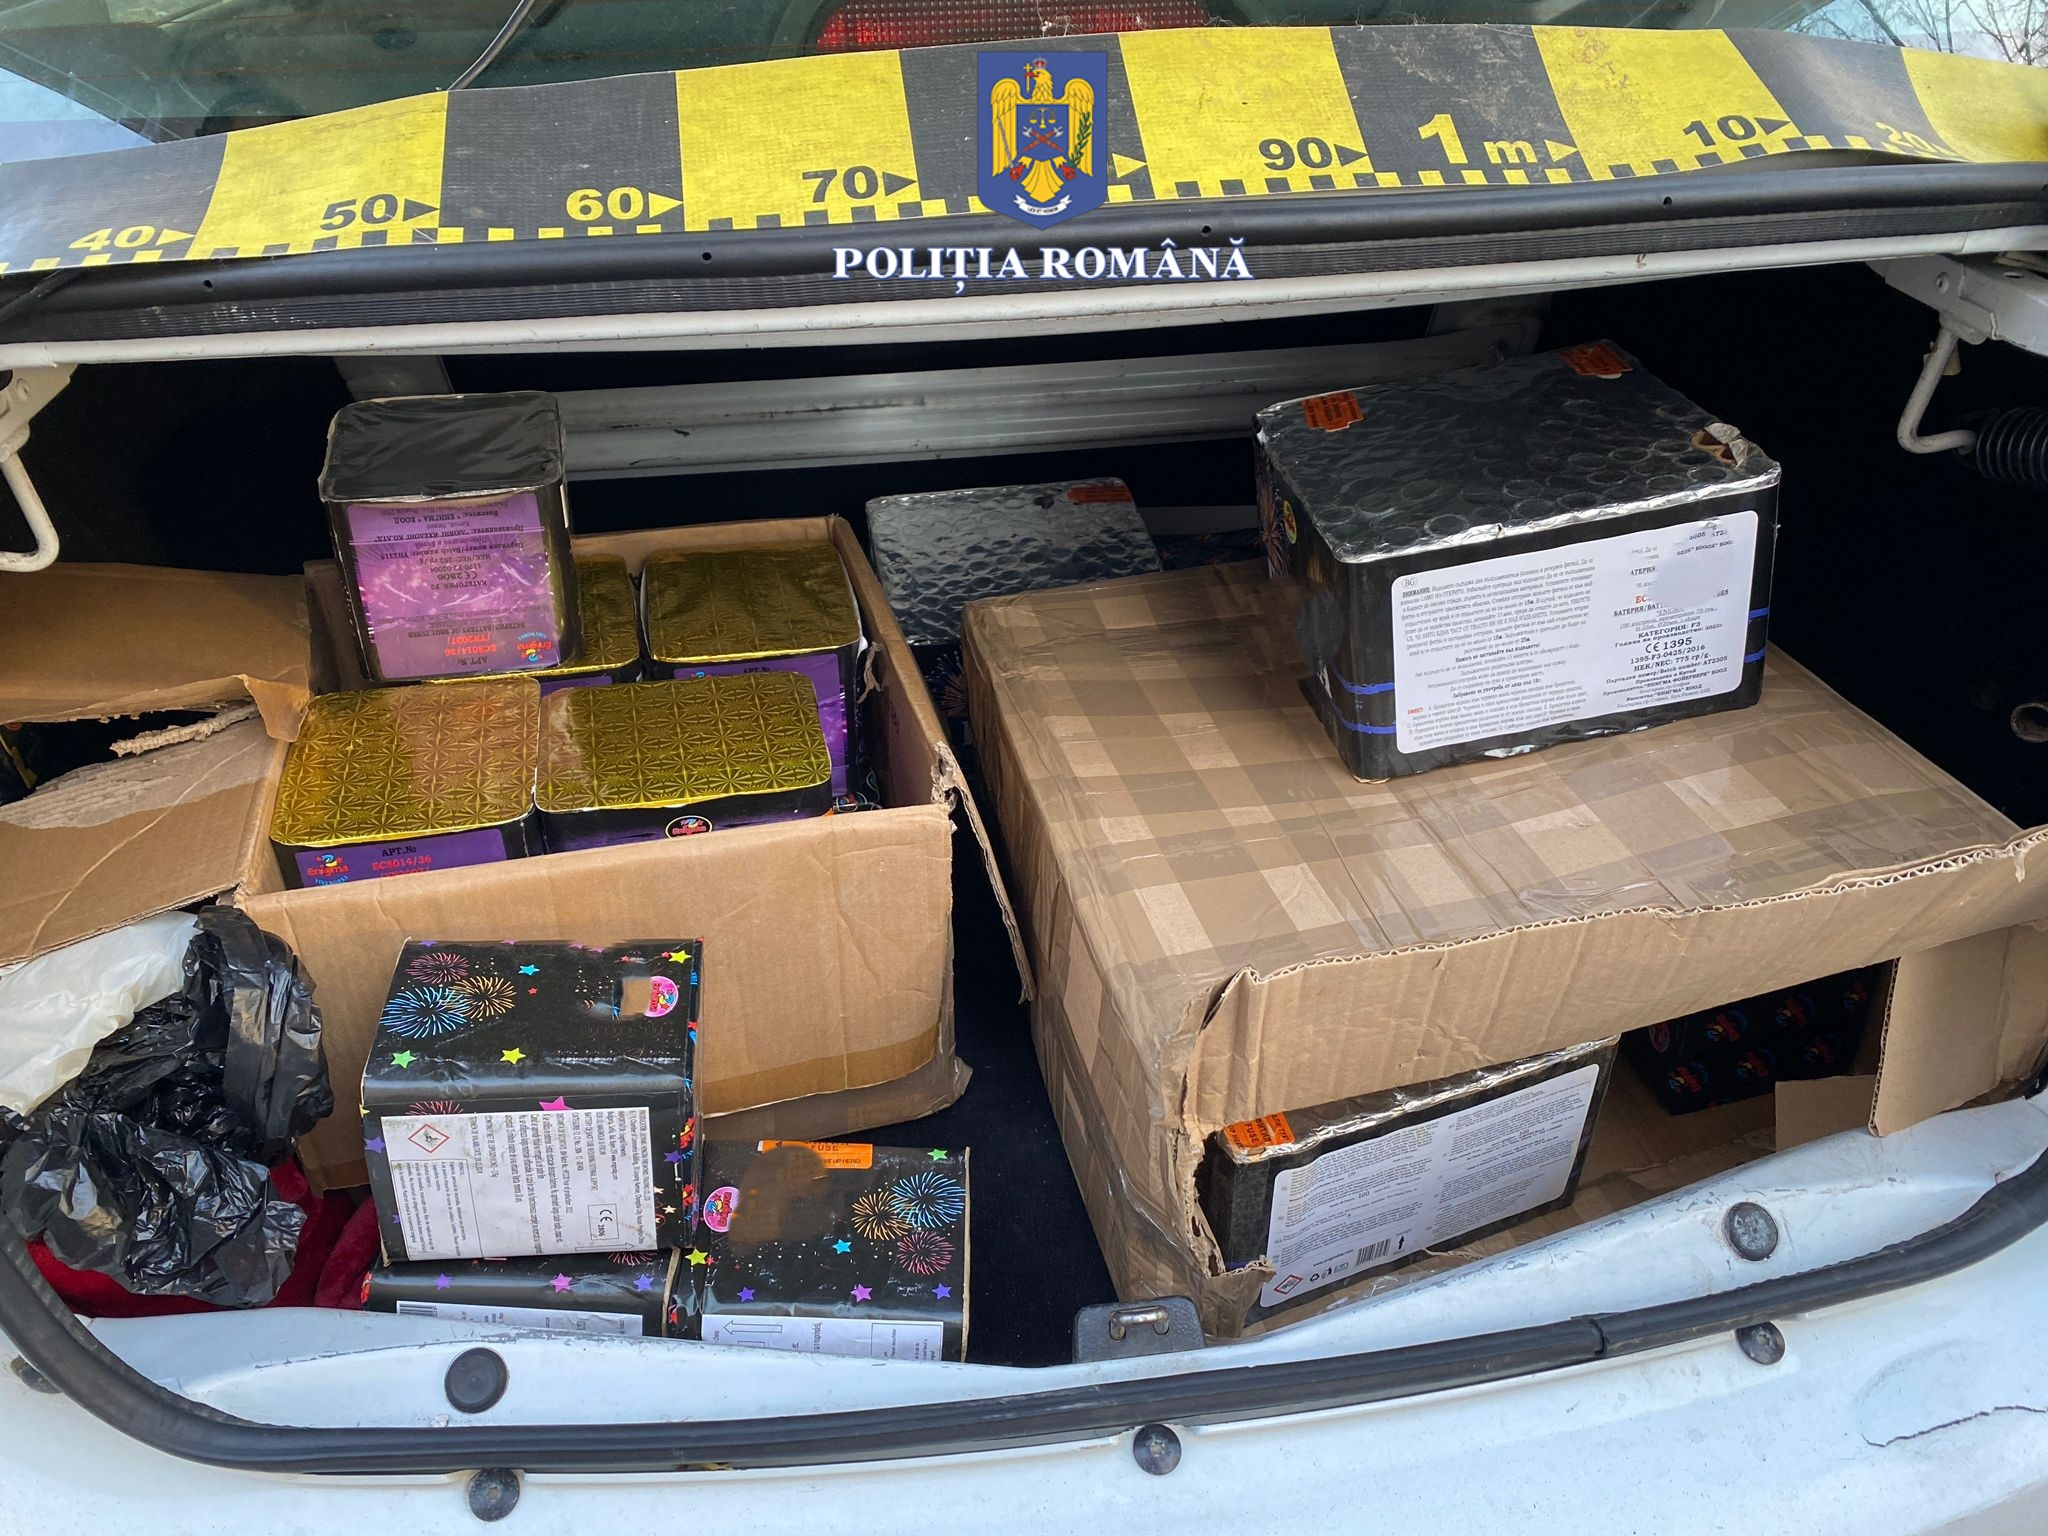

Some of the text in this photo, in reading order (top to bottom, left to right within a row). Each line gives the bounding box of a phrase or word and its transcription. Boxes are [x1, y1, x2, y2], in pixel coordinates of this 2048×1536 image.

[1417, 113, 1538, 164] 1 m
[1682, 114, 1756, 147] 10
[1875, 121, 1939, 151] 20
[1258, 137, 1333, 171] 90
[802, 165, 879, 203] 70
[320, 194, 398, 231] 50
[566, 187, 643, 221] 60
[69, 225, 156, 250] 40
[1663, 636, 1692, 650] 1395
[1675, 655, 1688, 663] 775
[306, 863, 349, 878] Enigma
[811, 1143, 839, 1152] FUSE
[1245, 1121, 1260, 1144] FUSE
